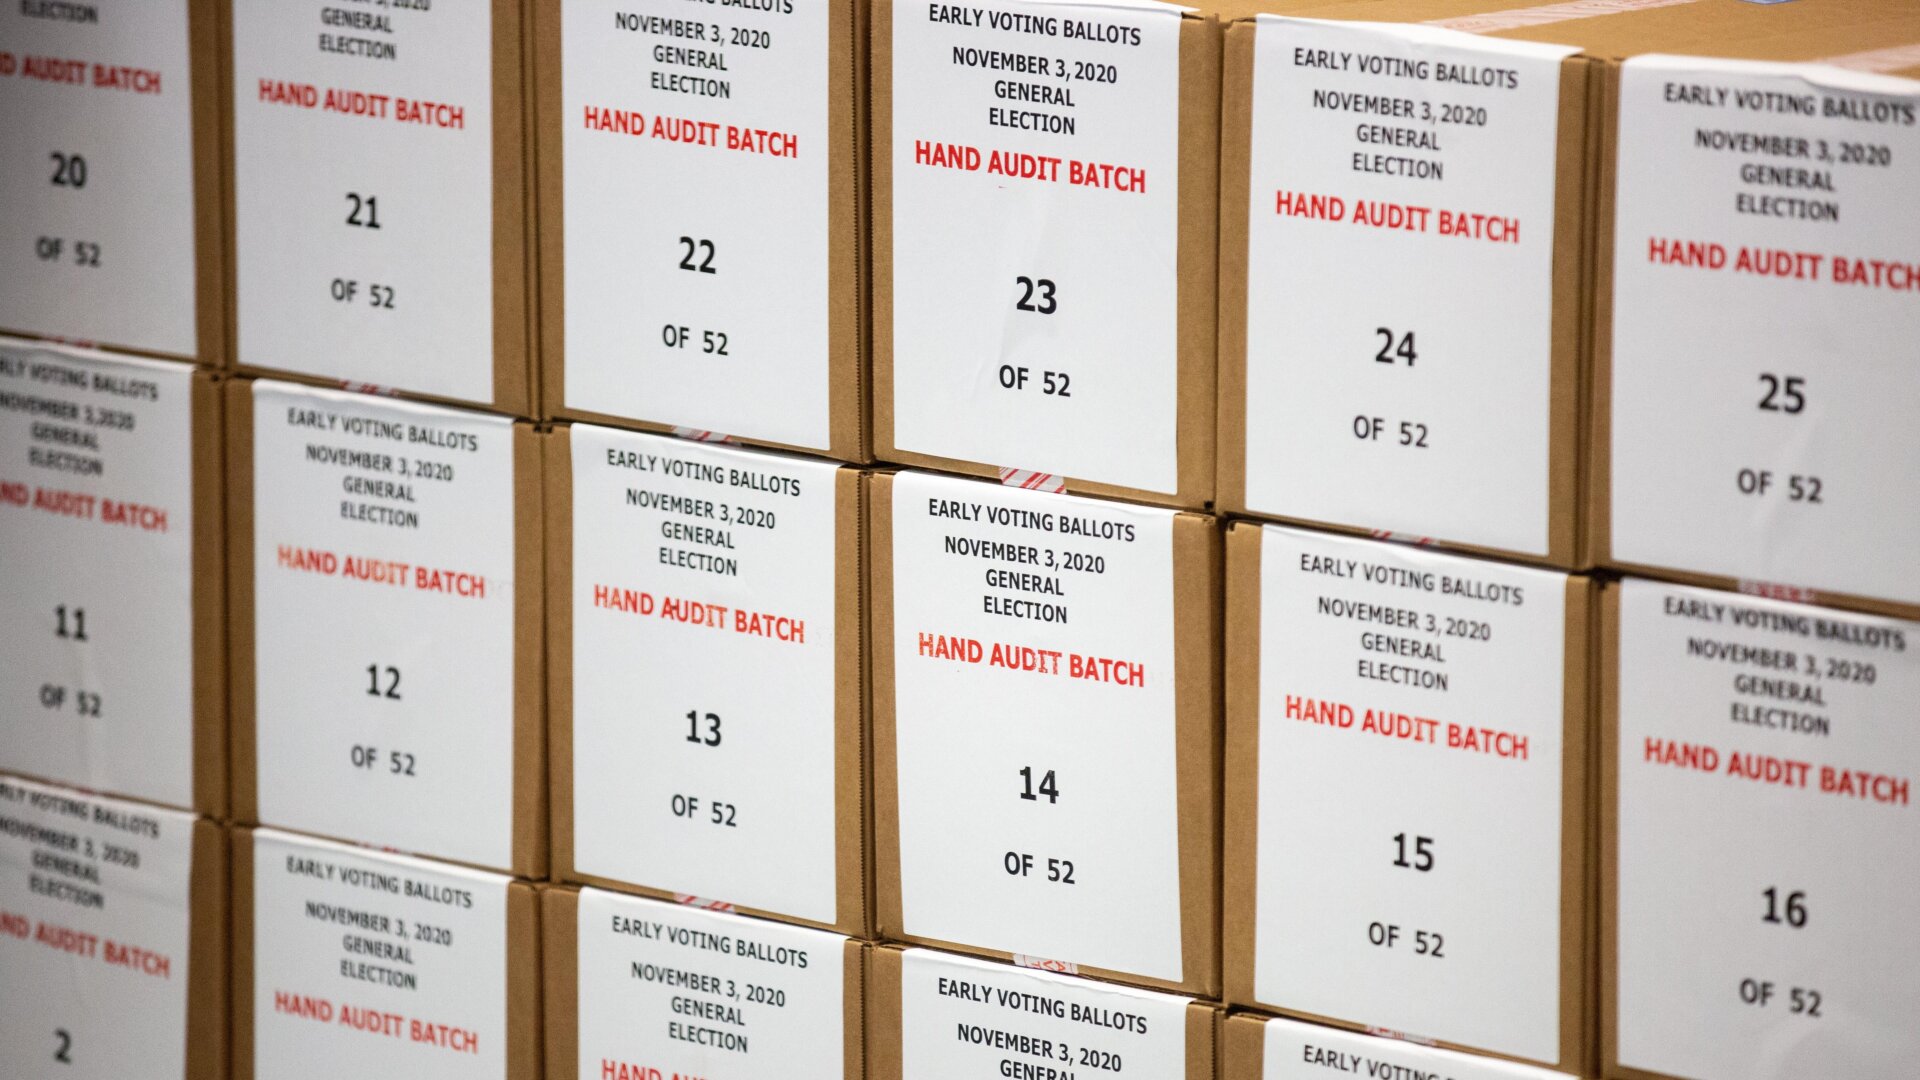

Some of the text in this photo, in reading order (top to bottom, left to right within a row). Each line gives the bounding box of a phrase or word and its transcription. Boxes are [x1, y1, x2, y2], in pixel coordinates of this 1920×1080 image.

[321, 7, 393, 34] GENERAL
[616, 12, 706, 40] NOVEMBER
[731, 27, 770, 49] 2020
[930, 3, 1141, 46] EARLY VOTING BALLOTS
[319, 33, 396, 60] ELECTION
[653, 45, 728, 71] GENERAL
[953, 46, 1050, 76] NOVEMBER
[651, 71, 730, 99] ELECTION
[1294, 47, 1518, 89] EARLY VOTING BALLOTS
[259, 79, 464, 129] HAND AUDIT BATCH
[995, 80, 1075, 107] GENERAL
[1314, 89, 1415, 118] NOVEMBER
[1664, 82, 1916, 126] EARLY VOTING BALLOTS
[584, 105, 797, 158] HAND AUDIT BATCH
[990, 107, 1075, 135] ELECTION
[1357, 123, 1441, 151] GENERAL
[49, 151, 87, 190] 20
[915, 140, 1145, 193] HAND AUDIT BATCH
[1353, 152, 1443, 180] ELECTION
[1740, 163, 1835, 192] GENERAL
[345, 192, 381, 230] 21
[1276, 190, 1520, 244] HAND AUDIT BATCH
[1736, 193, 1839, 222] ELECTION
[35, 236, 101, 268] OF 52
[679, 236, 716, 274] 22
[1648, 237, 1727, 270] HAND
[1734, 247, 1824, 280] AUDIT
[331, 278, 394, 309] OF 52
[1016, 276, 1057, 314] 23
[662, 324, 728, 356] OF 52
[1375, 327, 1418, 367] 24
[999, 365, 1071, 397] OF 52
[1758, 373, 1806, 416] 25
[288, 407, 478, 452] EARLY VOTING BALLOTS
[1353, 415, 1428, 448] OF 52
[306, 445, 392, 472] NOVEMBER
[607, 448, 800, 496] EARLY VOTING BALLOTS
[343, 476, 415, 502] GENERAL
[626, 488, 714, 519] NOVEMBER
[1737, 468, 1822, 504] OF 52
[341, 501, 418, 528] ELECTION
[929, 498, 1135, 542] EARLY VOTING BALLOTS
[661, 521, 735, 549] GENERAL
[945, 536, 1039, 565] NOVEMBER
[278, 546, 485, 599] HAND AUDIT BATCH
[659, 547, 737, 576] ELECTION
[1301, 553, 1523, 606] EARLY VOTING BALLOTS
[986, 569, 1064, 596] GENERAL
[54, 604, 88, 642] 11
[594, 584, 804, 644] HAND AUDIT BATCH
[984, 595, 1067, 624] ELECTION
[1319, 596, 1419, 629] NOVEMBER
[1664, 596, 1906, 651] EARLY VOTING BALLOTS
[919, 632, 1144, 687] HAND AUDIT BATCH
[1361, 632, 1445, 663] GENERAL
[366, 664, 401, 700] 12
[1358, 659, 1448, 691] ELECTION
[1734, 674, 1825, 706] GENERAL
[39, 684, 101, 718] OF 52
[1731, 702, 1829, 736] ELECTION
[686, 710, 722, 747] 13
[1286, 694, 1528, 760] HAND AUDIT BATCH
[351, 745, 415, 776] OF 52
[1644, 736, 1909, 806] HAND AUDIT BATCH
[1020, 766, 1059, 804] 14
[671, 794, 736, 827] OF 52
[1004, 852, 1075, 884] OF 52
[1393, 832, 1434, 872] 15
[287, 856, 472, 908] EARLY VOTING BALLOTS
[306, 901, 390, 933] NOVEMBER
[415, 923, 452, 946] 2020
[1762, 886, 1808, 929] 16
[343, 935, 413, 964] GENERAL
[612, 915, 808, 968] EARLY VOTING BALLOTS
[1368, 921, 1444, 958] OF 52
[341, 960, 416, 990] ELECTION
[632, 962, 721, 995] NOVEMBER
[746, 984, 785, 1007] 2020
[671, 996, 745, 1026] GENERAL
[939, 977, 1147, 1034] EARLY VOTING BALLOTS
[1739, 978, 1822, 1018] OF 52
[275, 992, 478, 1054] HAND AUDIT BATCH
[669, 1022, 747, 1053] ELECTION
[54, 1028, 71, 1065] 2
[958, 1023, 1053, 1059] NOVEMBER
[1080, 1048, 1121, 1072] 2020
[1304, 1044, 1362, 1073] EARLY
